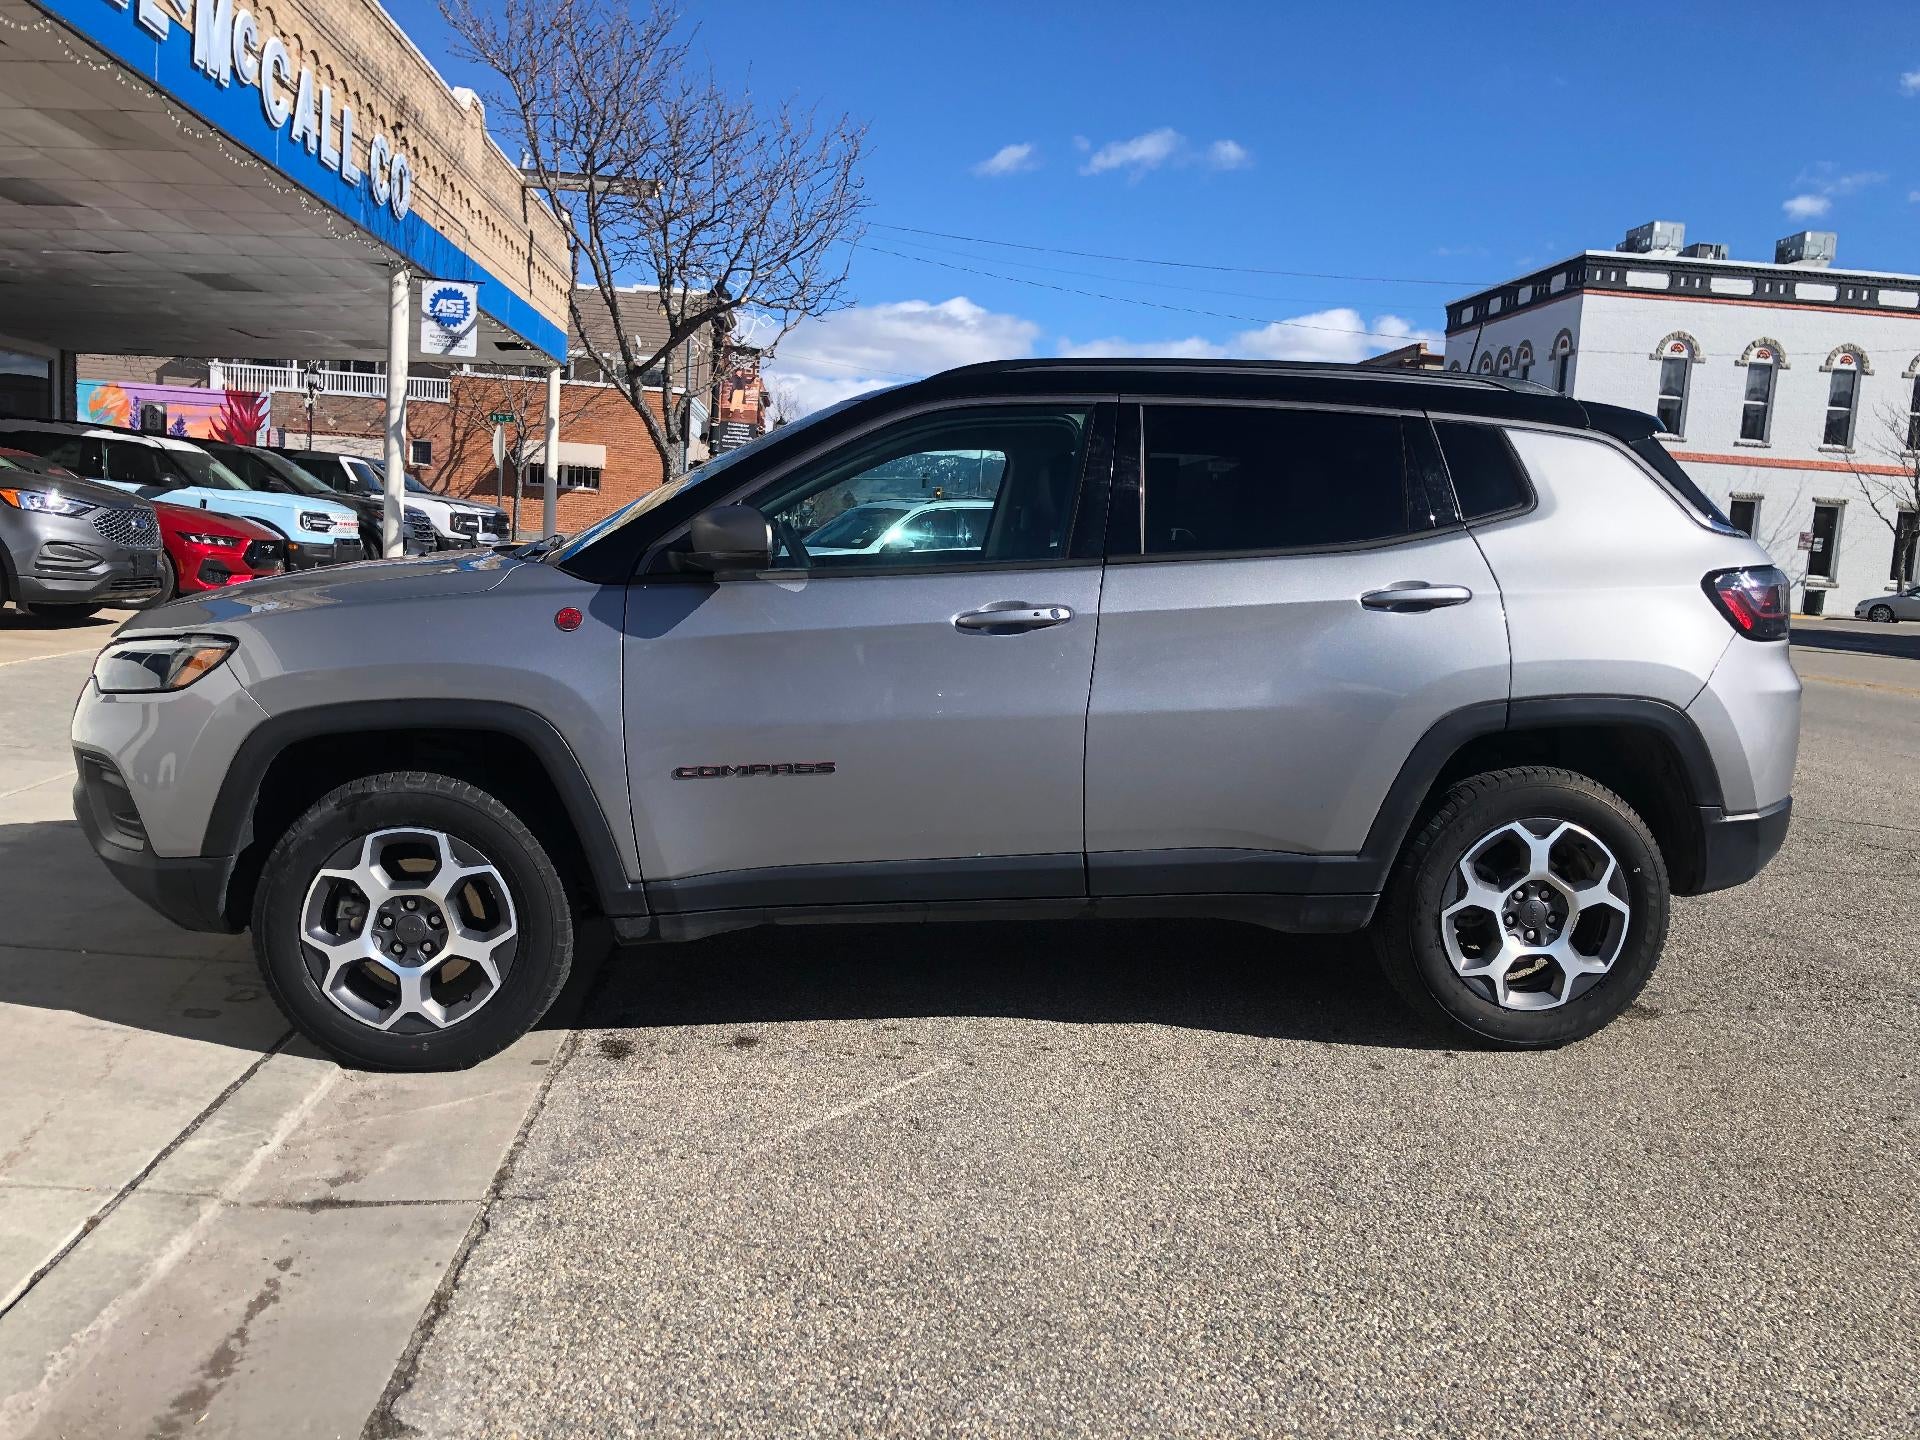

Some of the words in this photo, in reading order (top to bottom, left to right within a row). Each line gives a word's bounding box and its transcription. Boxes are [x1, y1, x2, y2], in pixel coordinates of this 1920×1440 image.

[369, 133, 412, 221] CO
[434, 298, 465, 314] ASE
[671, 761, 837, 780] COMPASS
